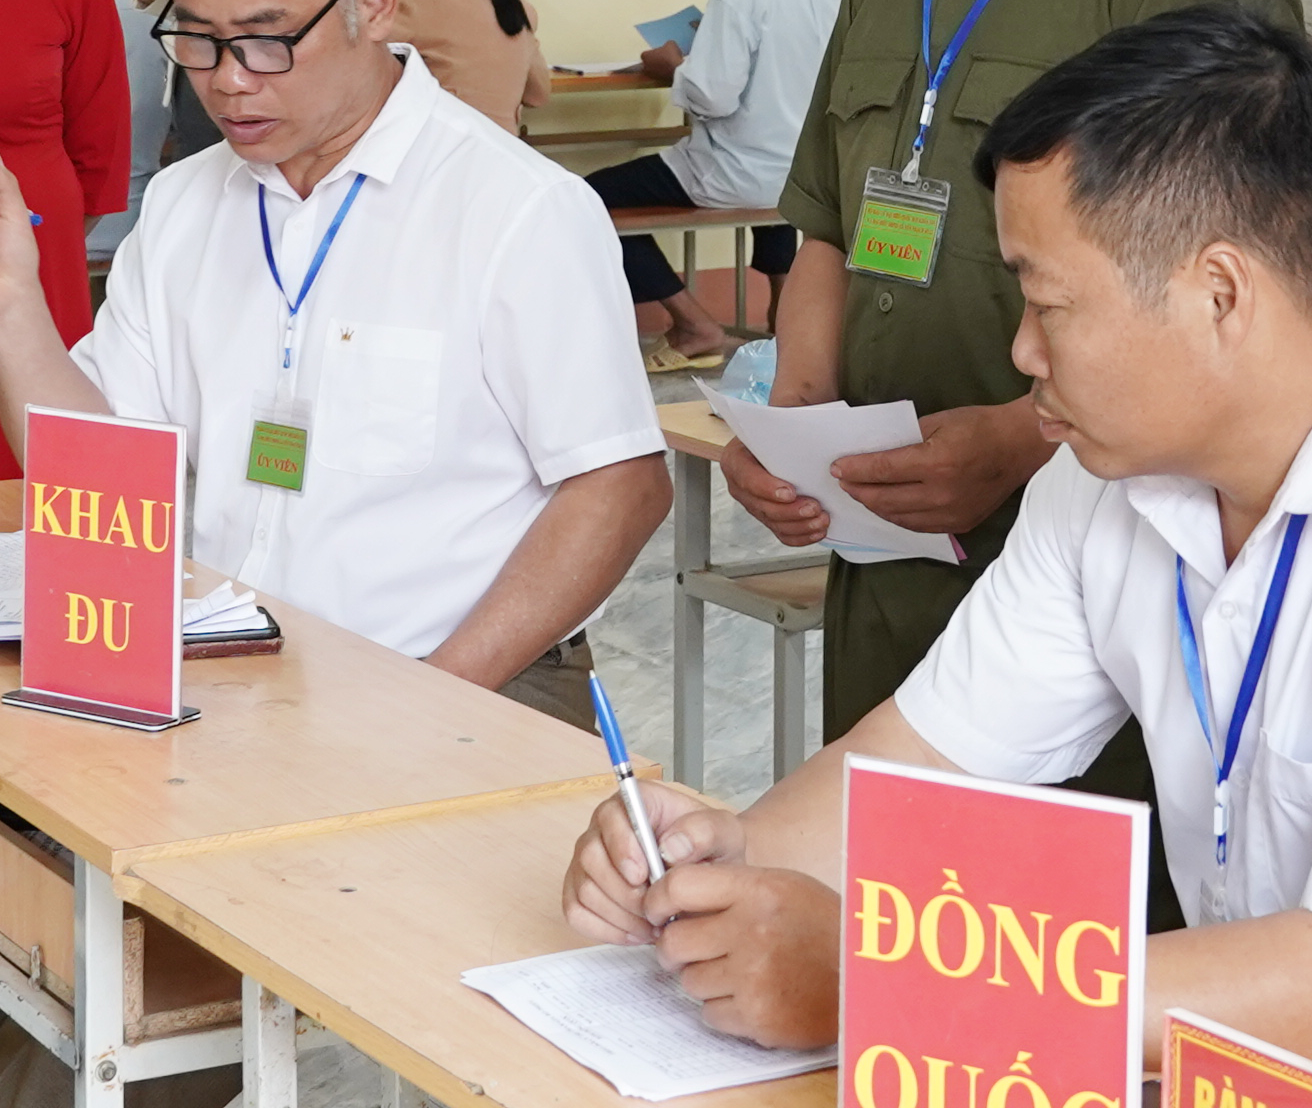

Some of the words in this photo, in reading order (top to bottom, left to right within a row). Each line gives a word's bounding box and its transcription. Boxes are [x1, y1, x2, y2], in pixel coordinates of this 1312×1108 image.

[889, 244, 923, 261] VIÊN
[274, 458, 298, 472] VIÊN
[30, 481, 173, 553] KHAU
[64, 591, 134, 652] ĐU
[854, 868, 1126, 1008] ĐỒNG
